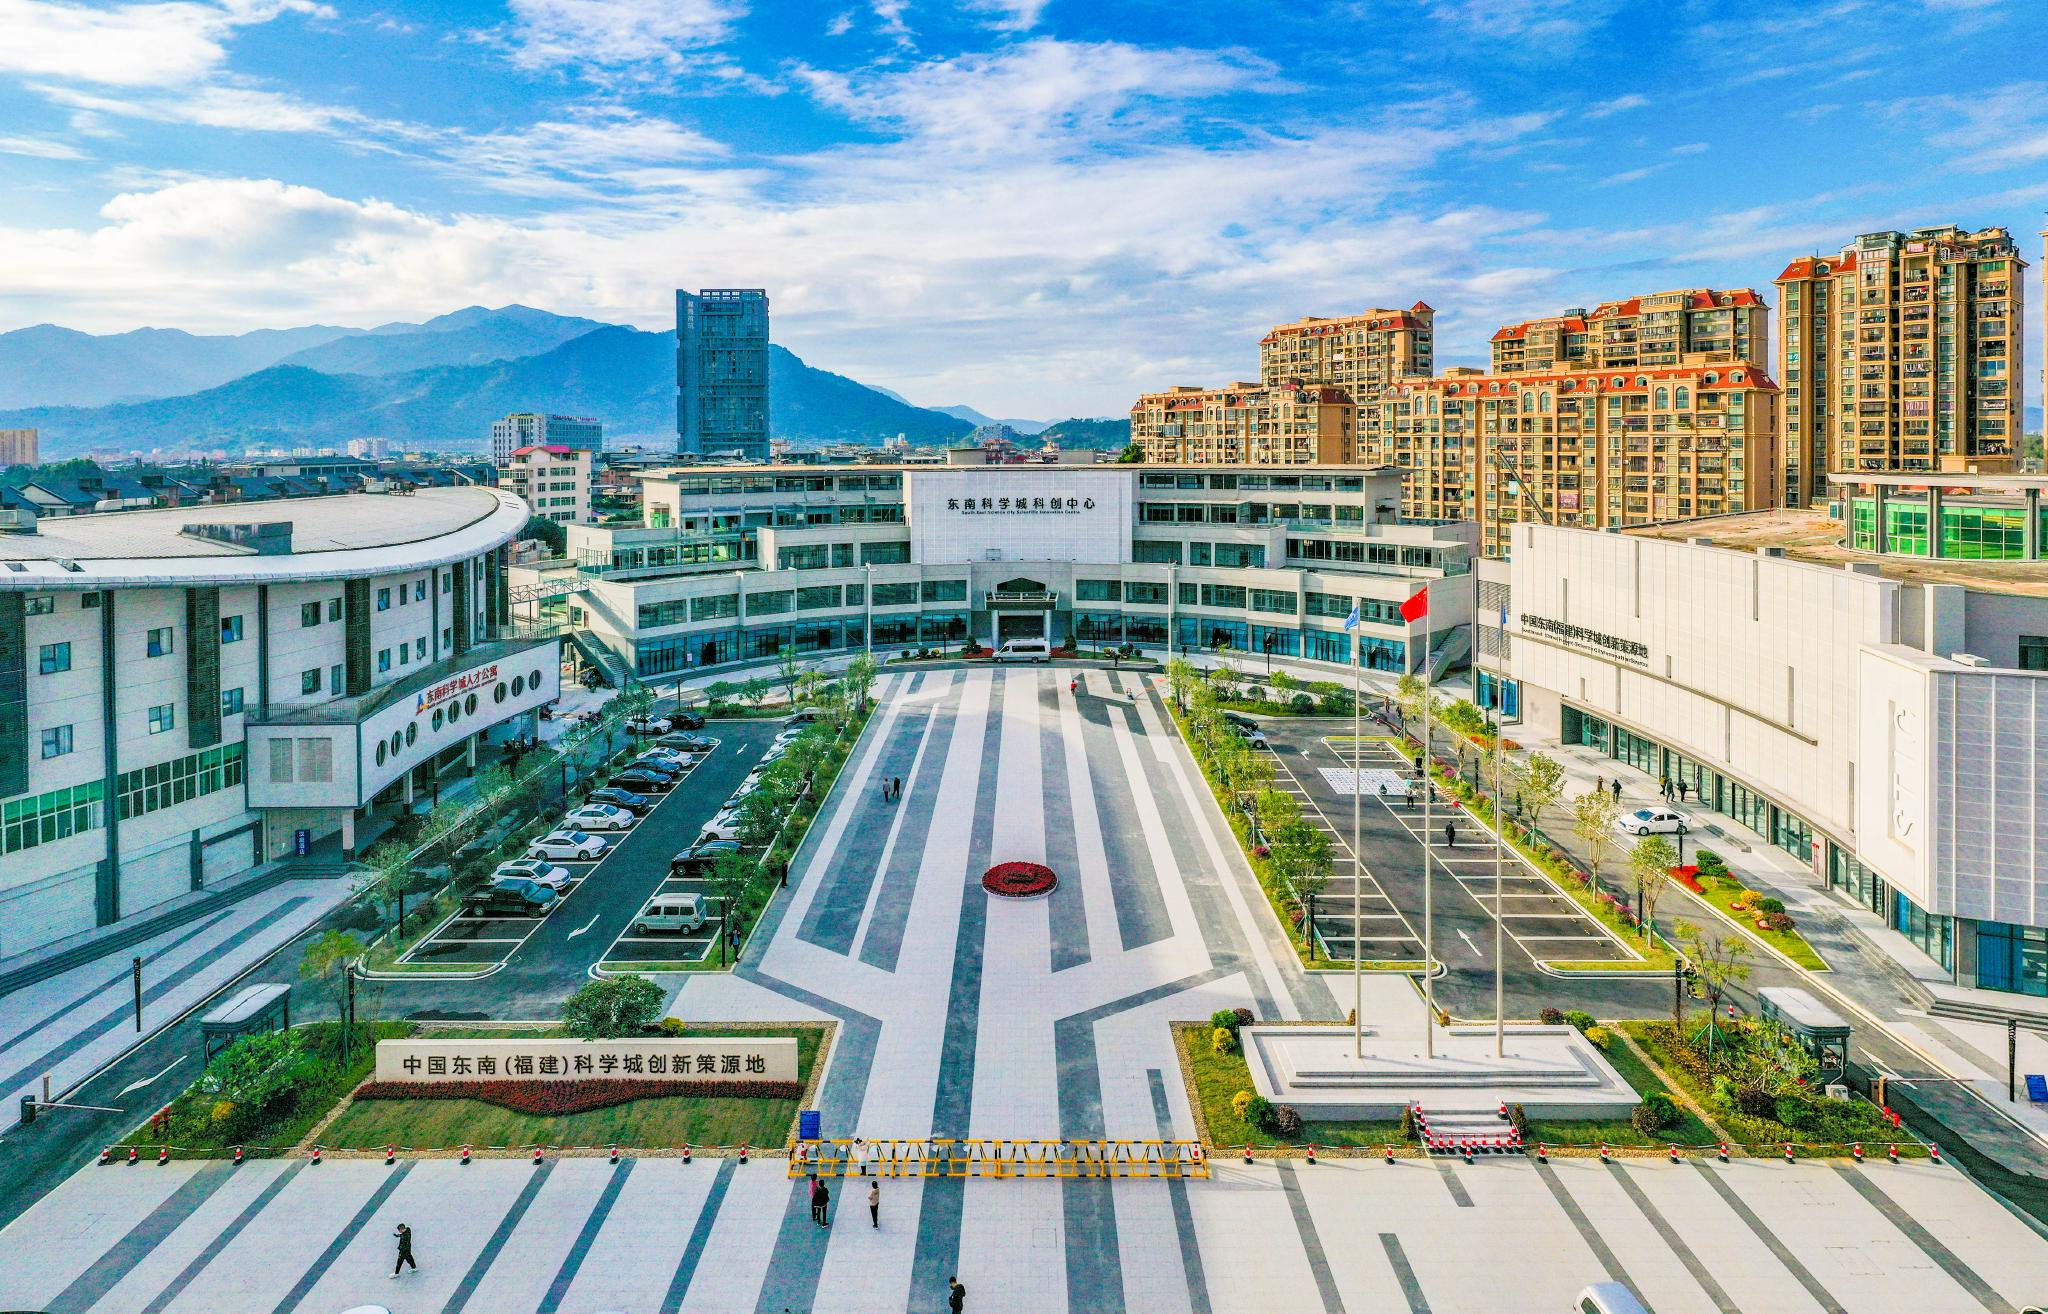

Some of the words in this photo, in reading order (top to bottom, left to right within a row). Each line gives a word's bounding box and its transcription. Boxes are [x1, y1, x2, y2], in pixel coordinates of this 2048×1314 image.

[947, 497, 1095, 510] 东南科学城科创中心
[427, 665, 497, 703] 东南科学城人才公寓
[403, 1054, 766, 1075] 中国东南(福建)科学城创新策源地
